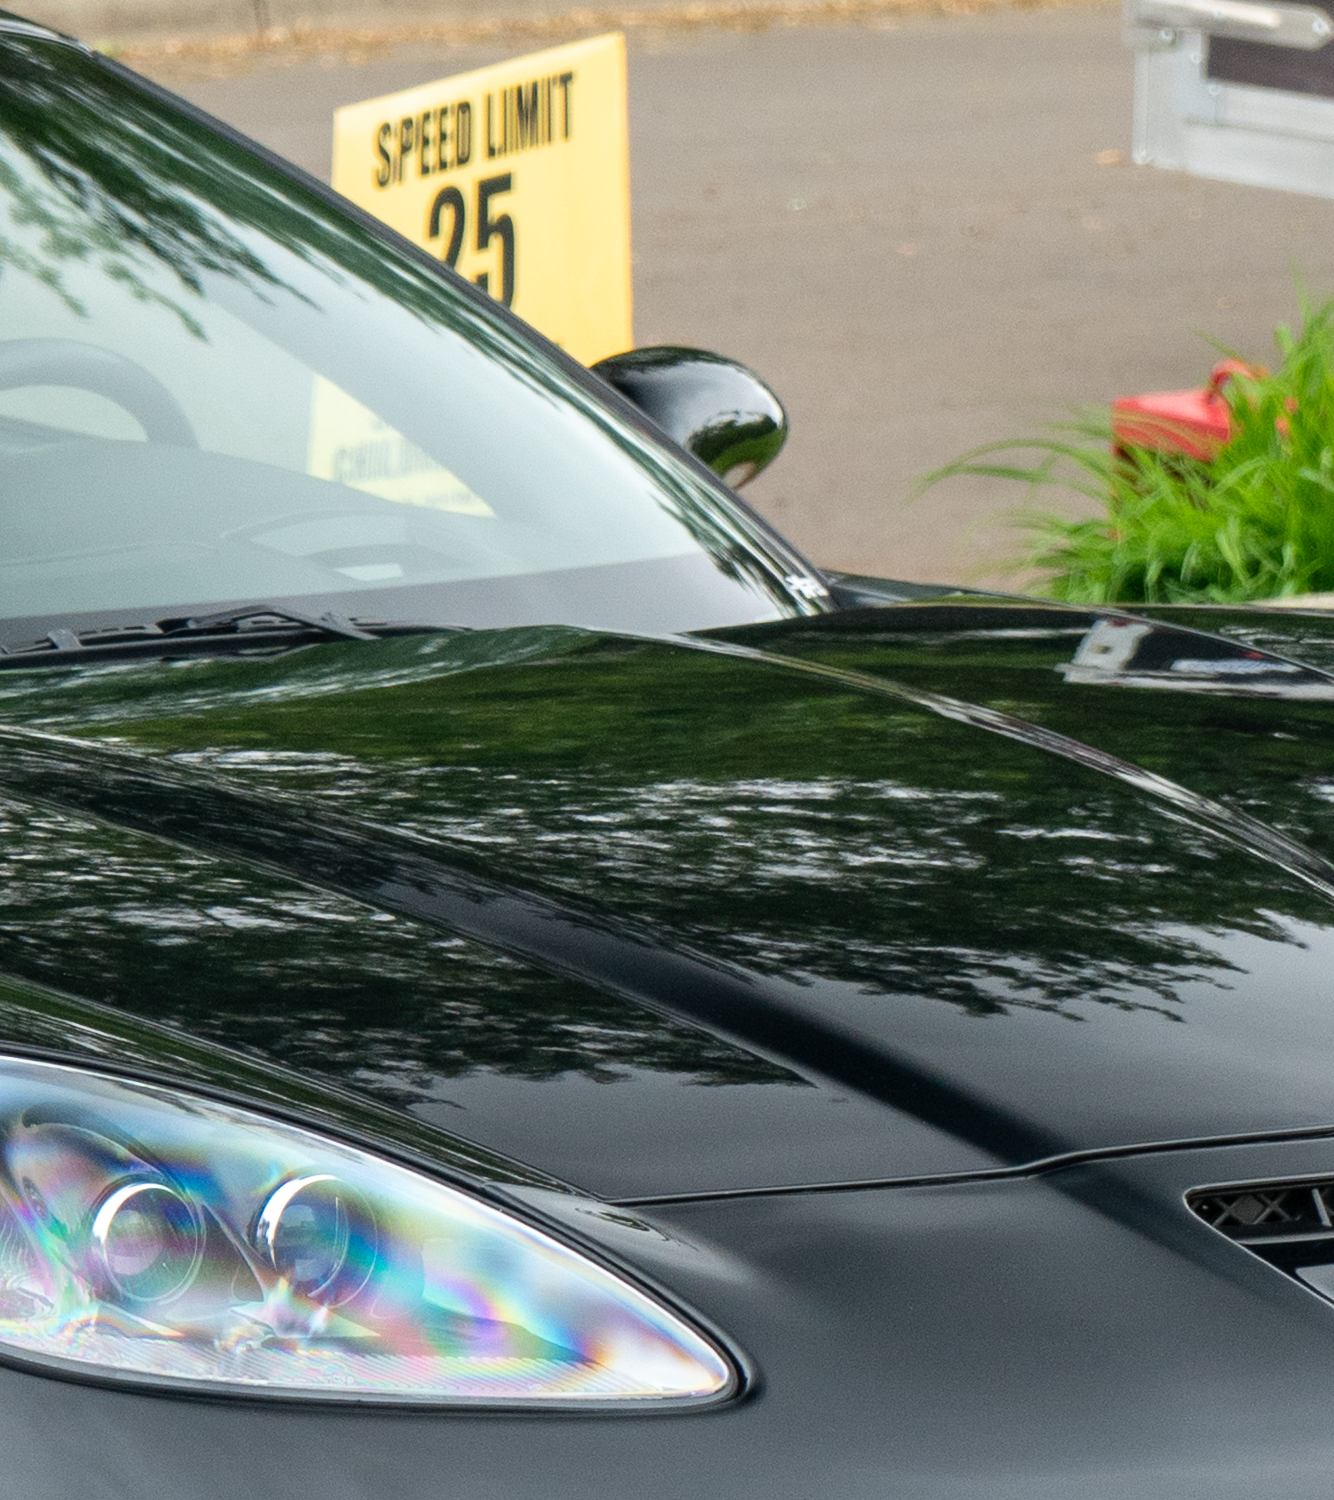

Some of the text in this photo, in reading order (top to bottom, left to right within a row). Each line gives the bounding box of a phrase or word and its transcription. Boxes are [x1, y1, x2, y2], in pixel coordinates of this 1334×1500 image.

[372, 70, 574, 188] SPEED LIMIT
[428, 172, 516, 311] 25
